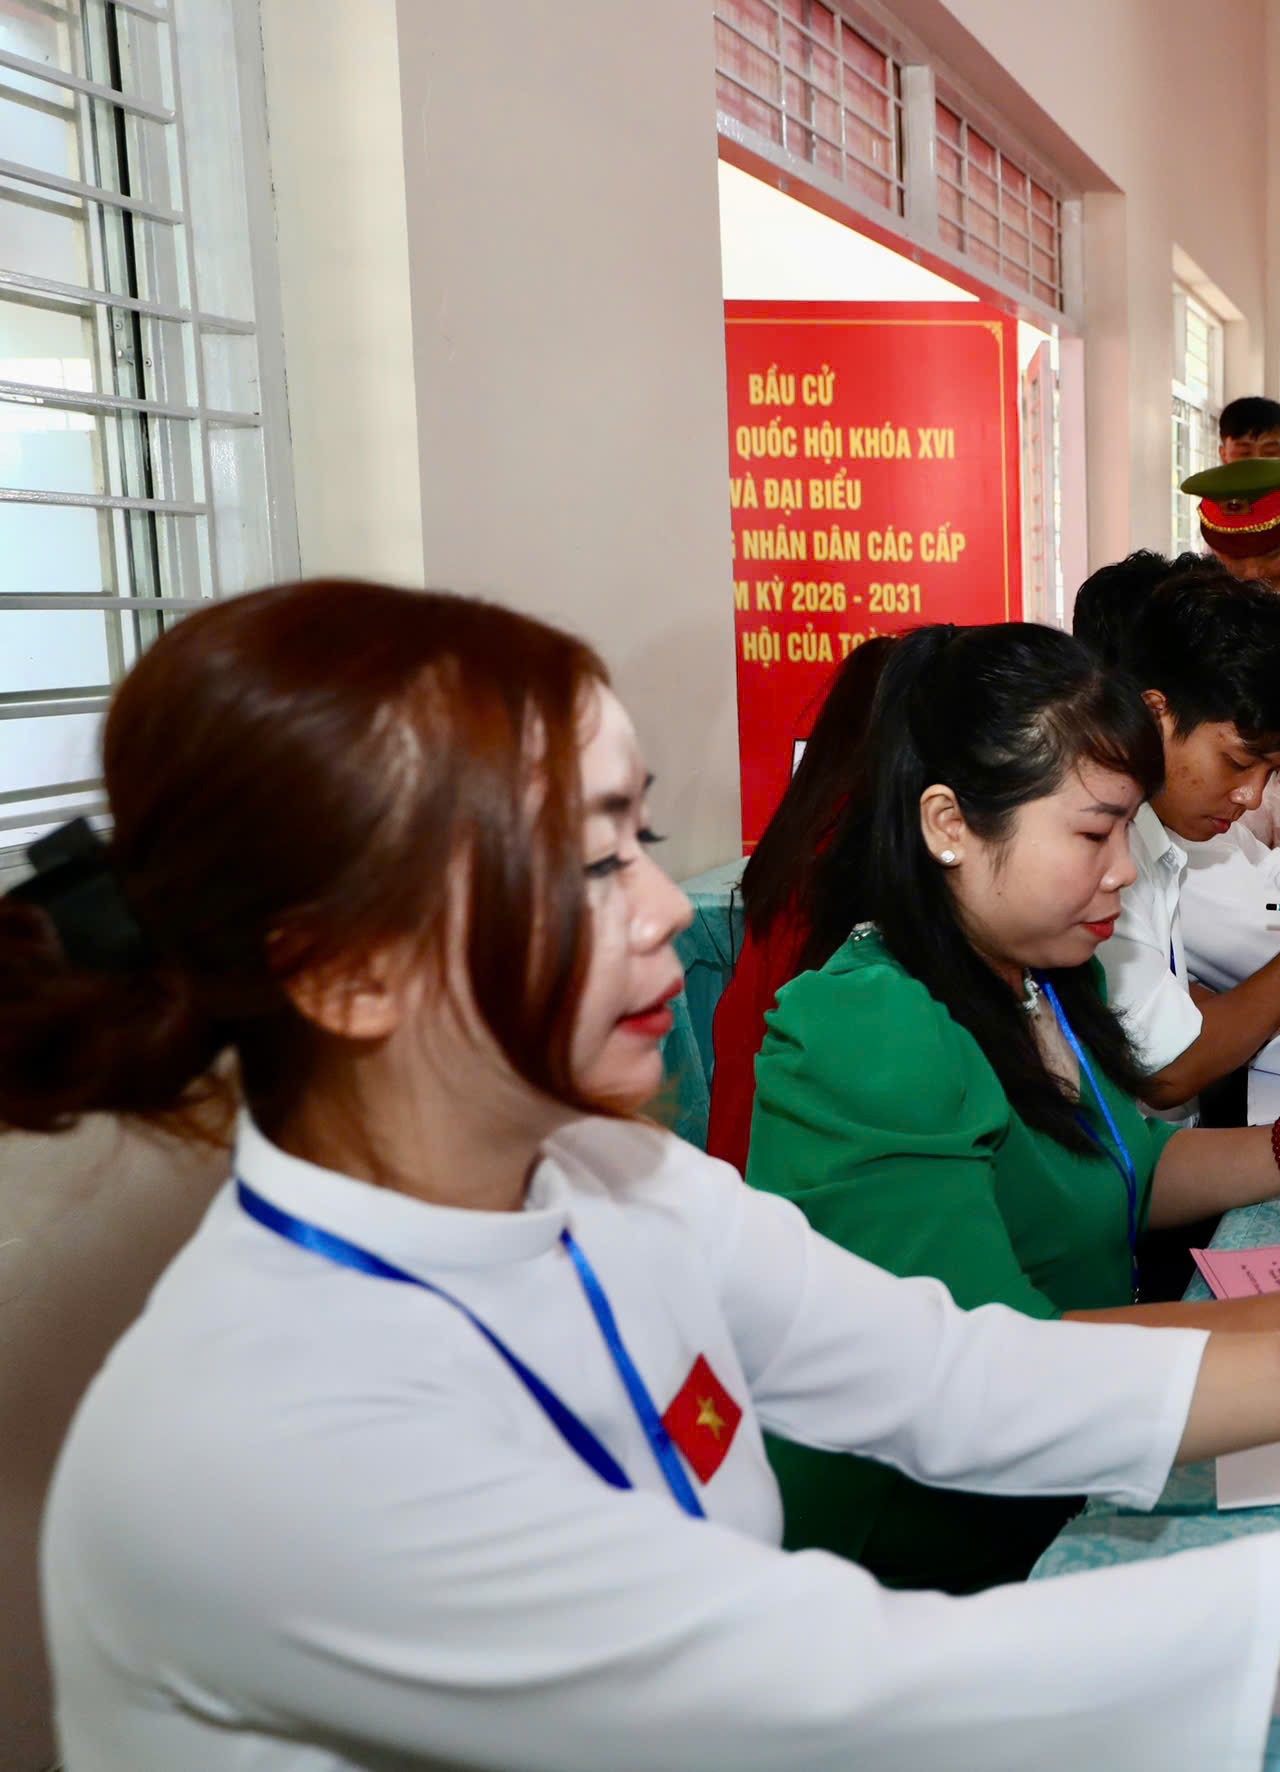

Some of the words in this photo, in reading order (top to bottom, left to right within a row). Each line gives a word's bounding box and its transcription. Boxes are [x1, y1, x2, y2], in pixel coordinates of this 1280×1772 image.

[748, 362, 796, 406] BẦU
[802, 362, 836, 406] CỬ
[736, 415, 798, 461] QUỐC
[804, 420, 843, 464] HỘI
[849, 421, 912, 459] KHÓA
[918, 428, 956, 459] XVI
[730, 471, 760, 510] VÀ
[764, 479, 802, 517] ĐẠI
[809, 467, 863, 511] BIỂU
[742, 523, 807, 561] NHÂN
[813, 524, 862, 562] DÂN
[867, 525, 914, 563] CÁC
[919, 521, 966, 563] CẤP
[756, 575, 785, 612] KỲ
[791, 581, 847, 612] 2026
[868, 582, 922, 613] 2031
[742, 625, 781, 669] HỘI
[787, 621, 834, 663] CỦA
